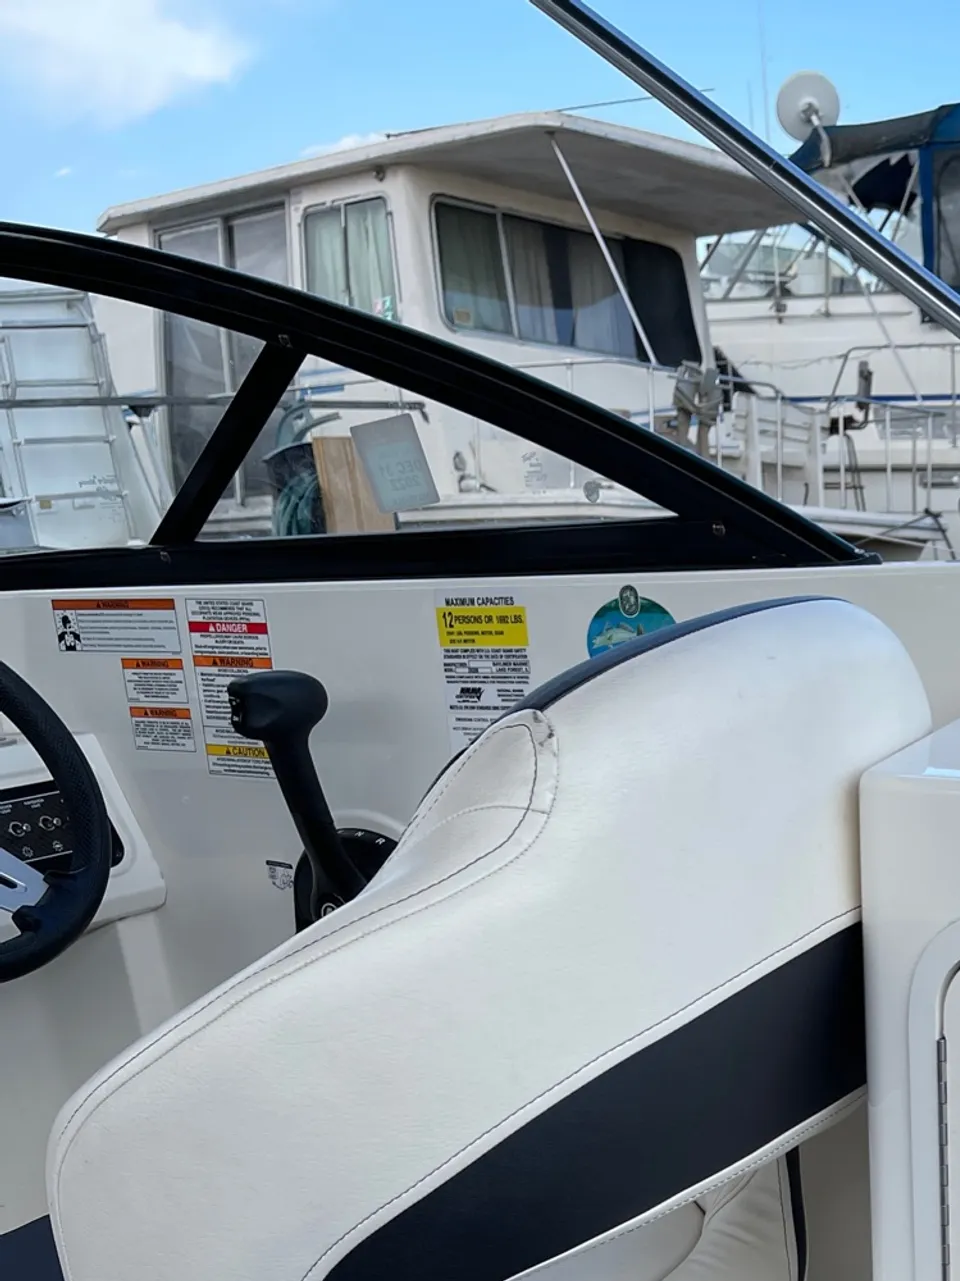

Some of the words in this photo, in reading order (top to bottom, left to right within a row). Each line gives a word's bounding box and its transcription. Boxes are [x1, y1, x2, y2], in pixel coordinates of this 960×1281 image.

[444, 597, 476, 607] MAXIMUM
[477, 596, 515, 606] CAPACITIES
[442, 611, 454, 628] 12
[454, 615, 482, 625] PERSONS
[484, 615, 494, 624] OR
[215, 623, 248, 633] DANGER
[218, 657, 255, 668] WARNING
[231, 747, 265, 757] CAUTION
[375, 837, 386, 845] R
